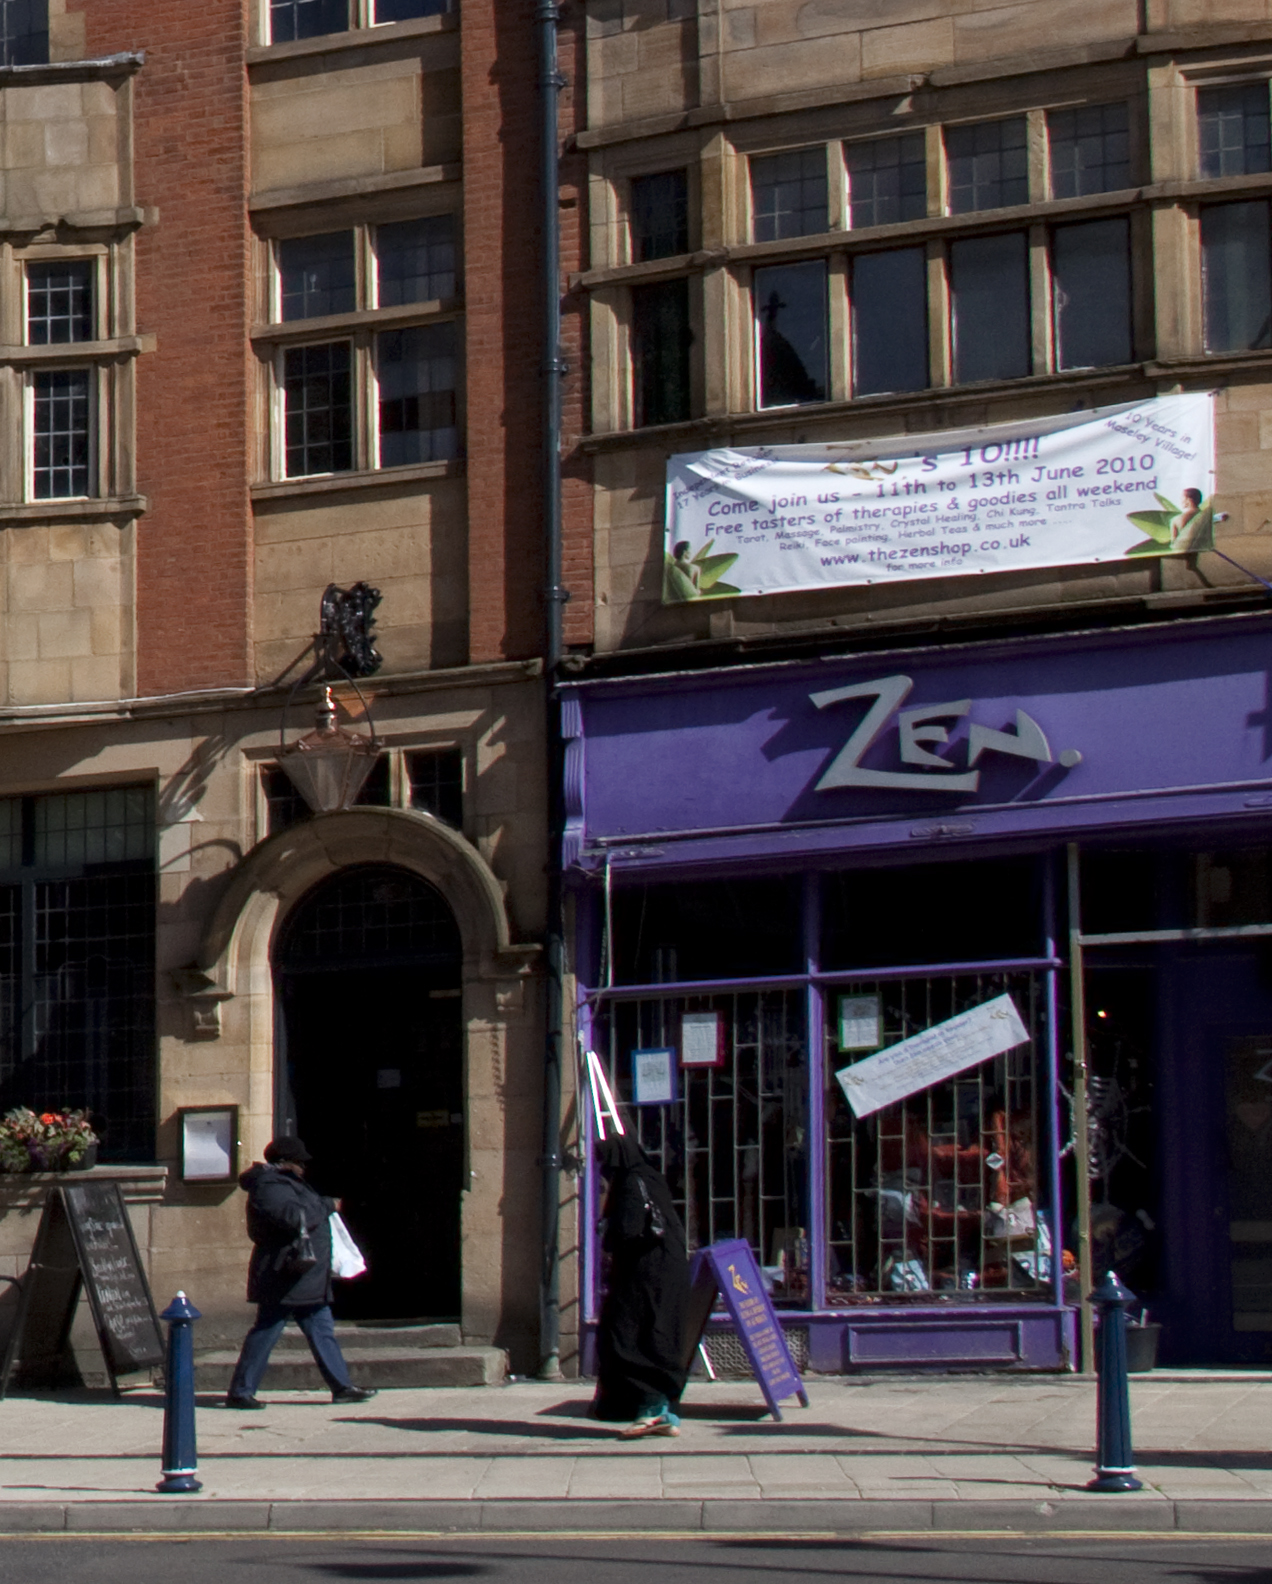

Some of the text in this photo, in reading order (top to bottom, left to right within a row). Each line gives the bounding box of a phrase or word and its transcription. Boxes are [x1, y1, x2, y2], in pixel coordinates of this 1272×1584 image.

[1104, 419, 1197, 461] Moseley Village!
[1144, 417, 1178, 438] Years
[1179, 432, 1192, 444] in
[707, 500, 760, 517] Come
[768, 494, 808, 515] join
[816, 491, 840, 505] us
[876, 479, 927, 498] 11th
[937, 479, 957, 493] to
[968, 472, 1021, 490] 13th
[1030, 464, 1085, 483] June
[1096, 454, 1155, 475] 2010
[705, 476, 1158, 537] Free tasters of therapies & goodies all weekend
[890, 516, 931, 529] Crystal
[986, 508, 1004, 519] Chi
[1046, 502, 1086, 512] Tantra
[1090, 497, 1123, 508] Talks
[815, 537, 840, 548] Face
[898, 526, 936, 539] Herbal
[940, 524, 969, 535] Teas
[984, 520, 1015, 531] much
[1018, 517, 1048, 528] more
[819, 533, 1032, 567] www.thezenshop.co.uk
[885, 556, 964, 572] for more info
